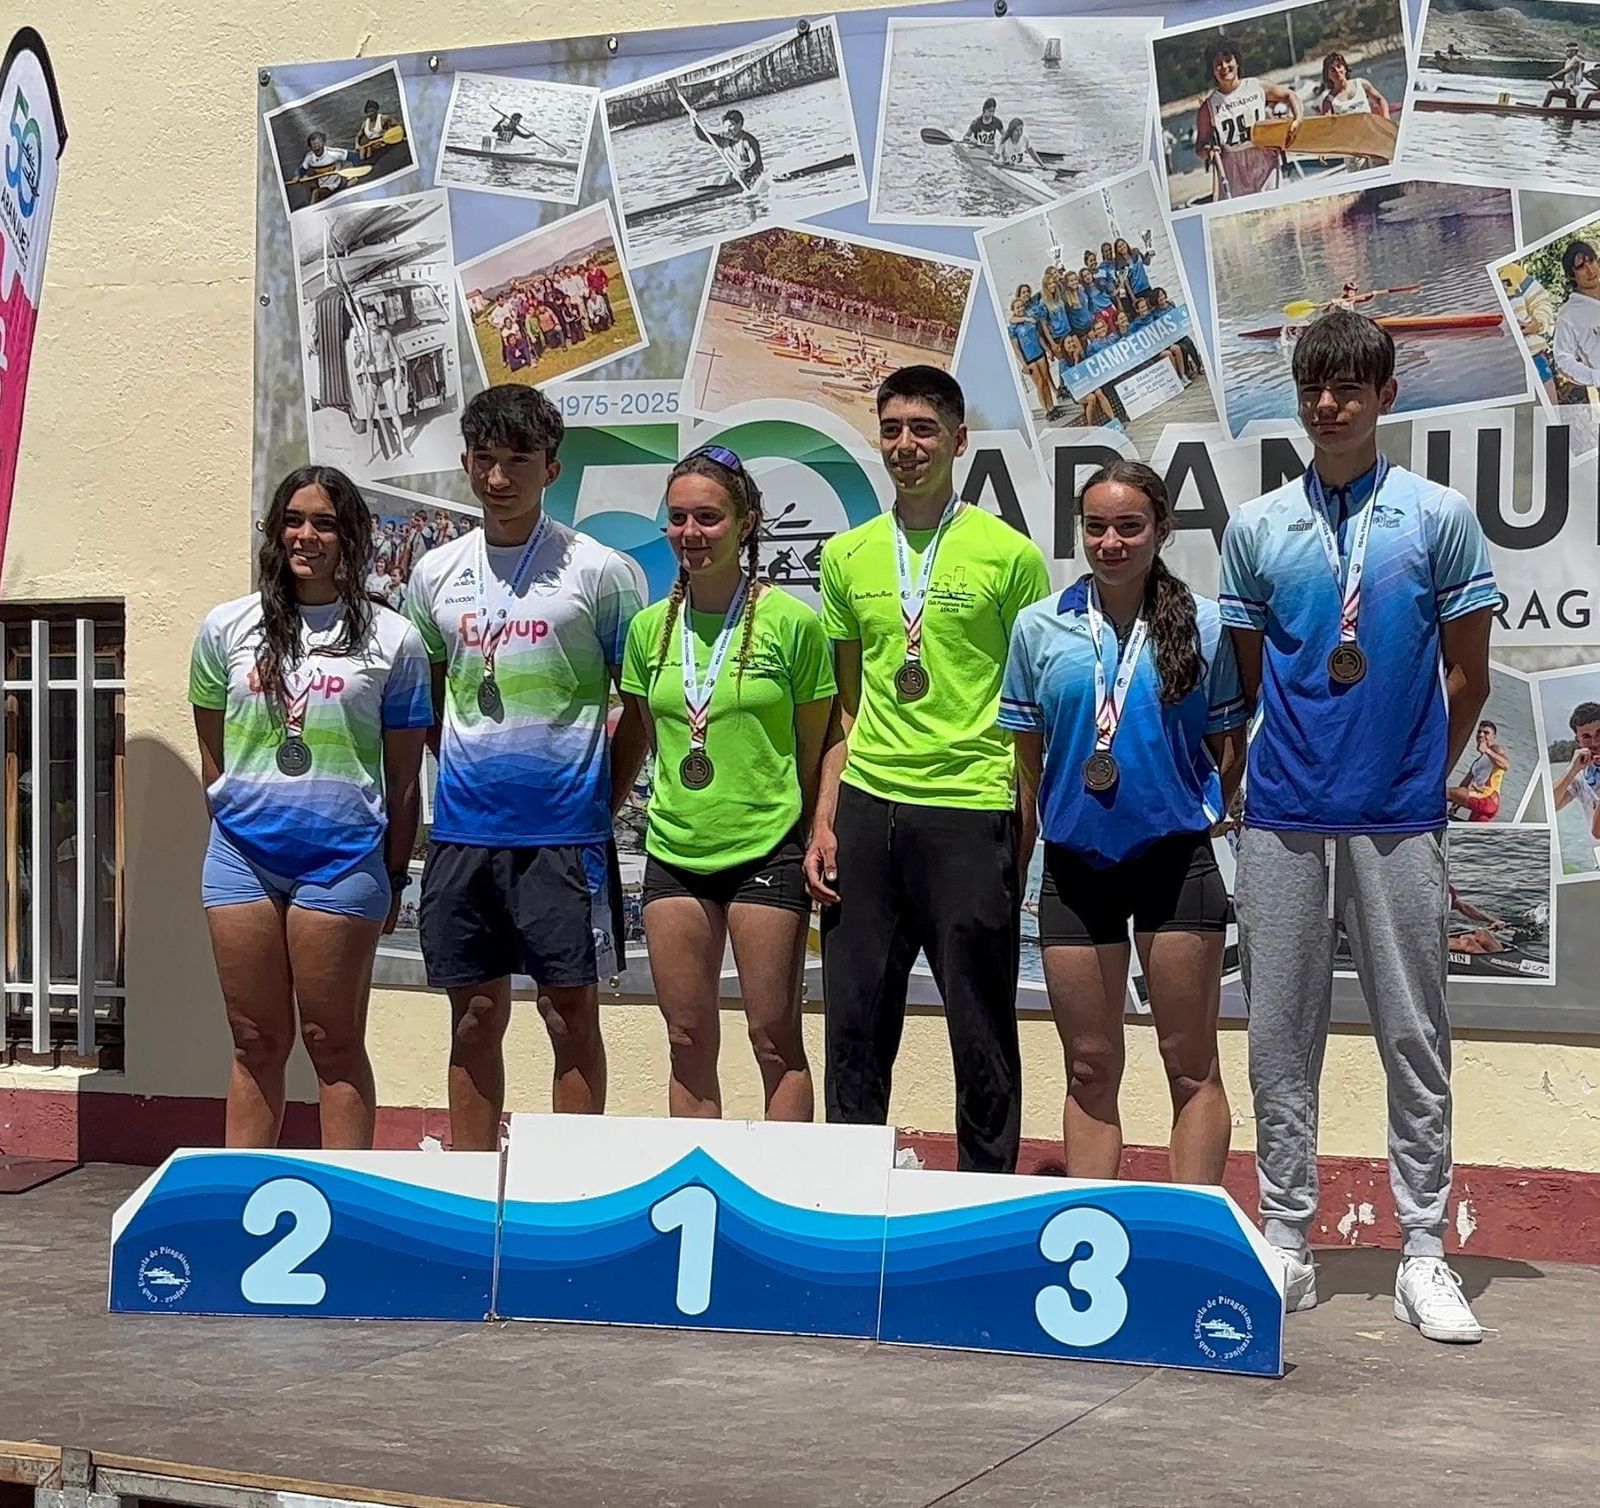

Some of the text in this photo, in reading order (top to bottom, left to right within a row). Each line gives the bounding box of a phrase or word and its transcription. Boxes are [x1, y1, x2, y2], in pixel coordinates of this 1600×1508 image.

[1085, 314, 1178, 378] CAMPEONAS
[558, 392, 680, 416] 1975-2025
[240, 1177, 332, 1305] 2
[650, 1184, 718, 1316] 1
[1035, 1207, 1130, 1347] 3
[1199, 1340, 1216, 1358] Club
